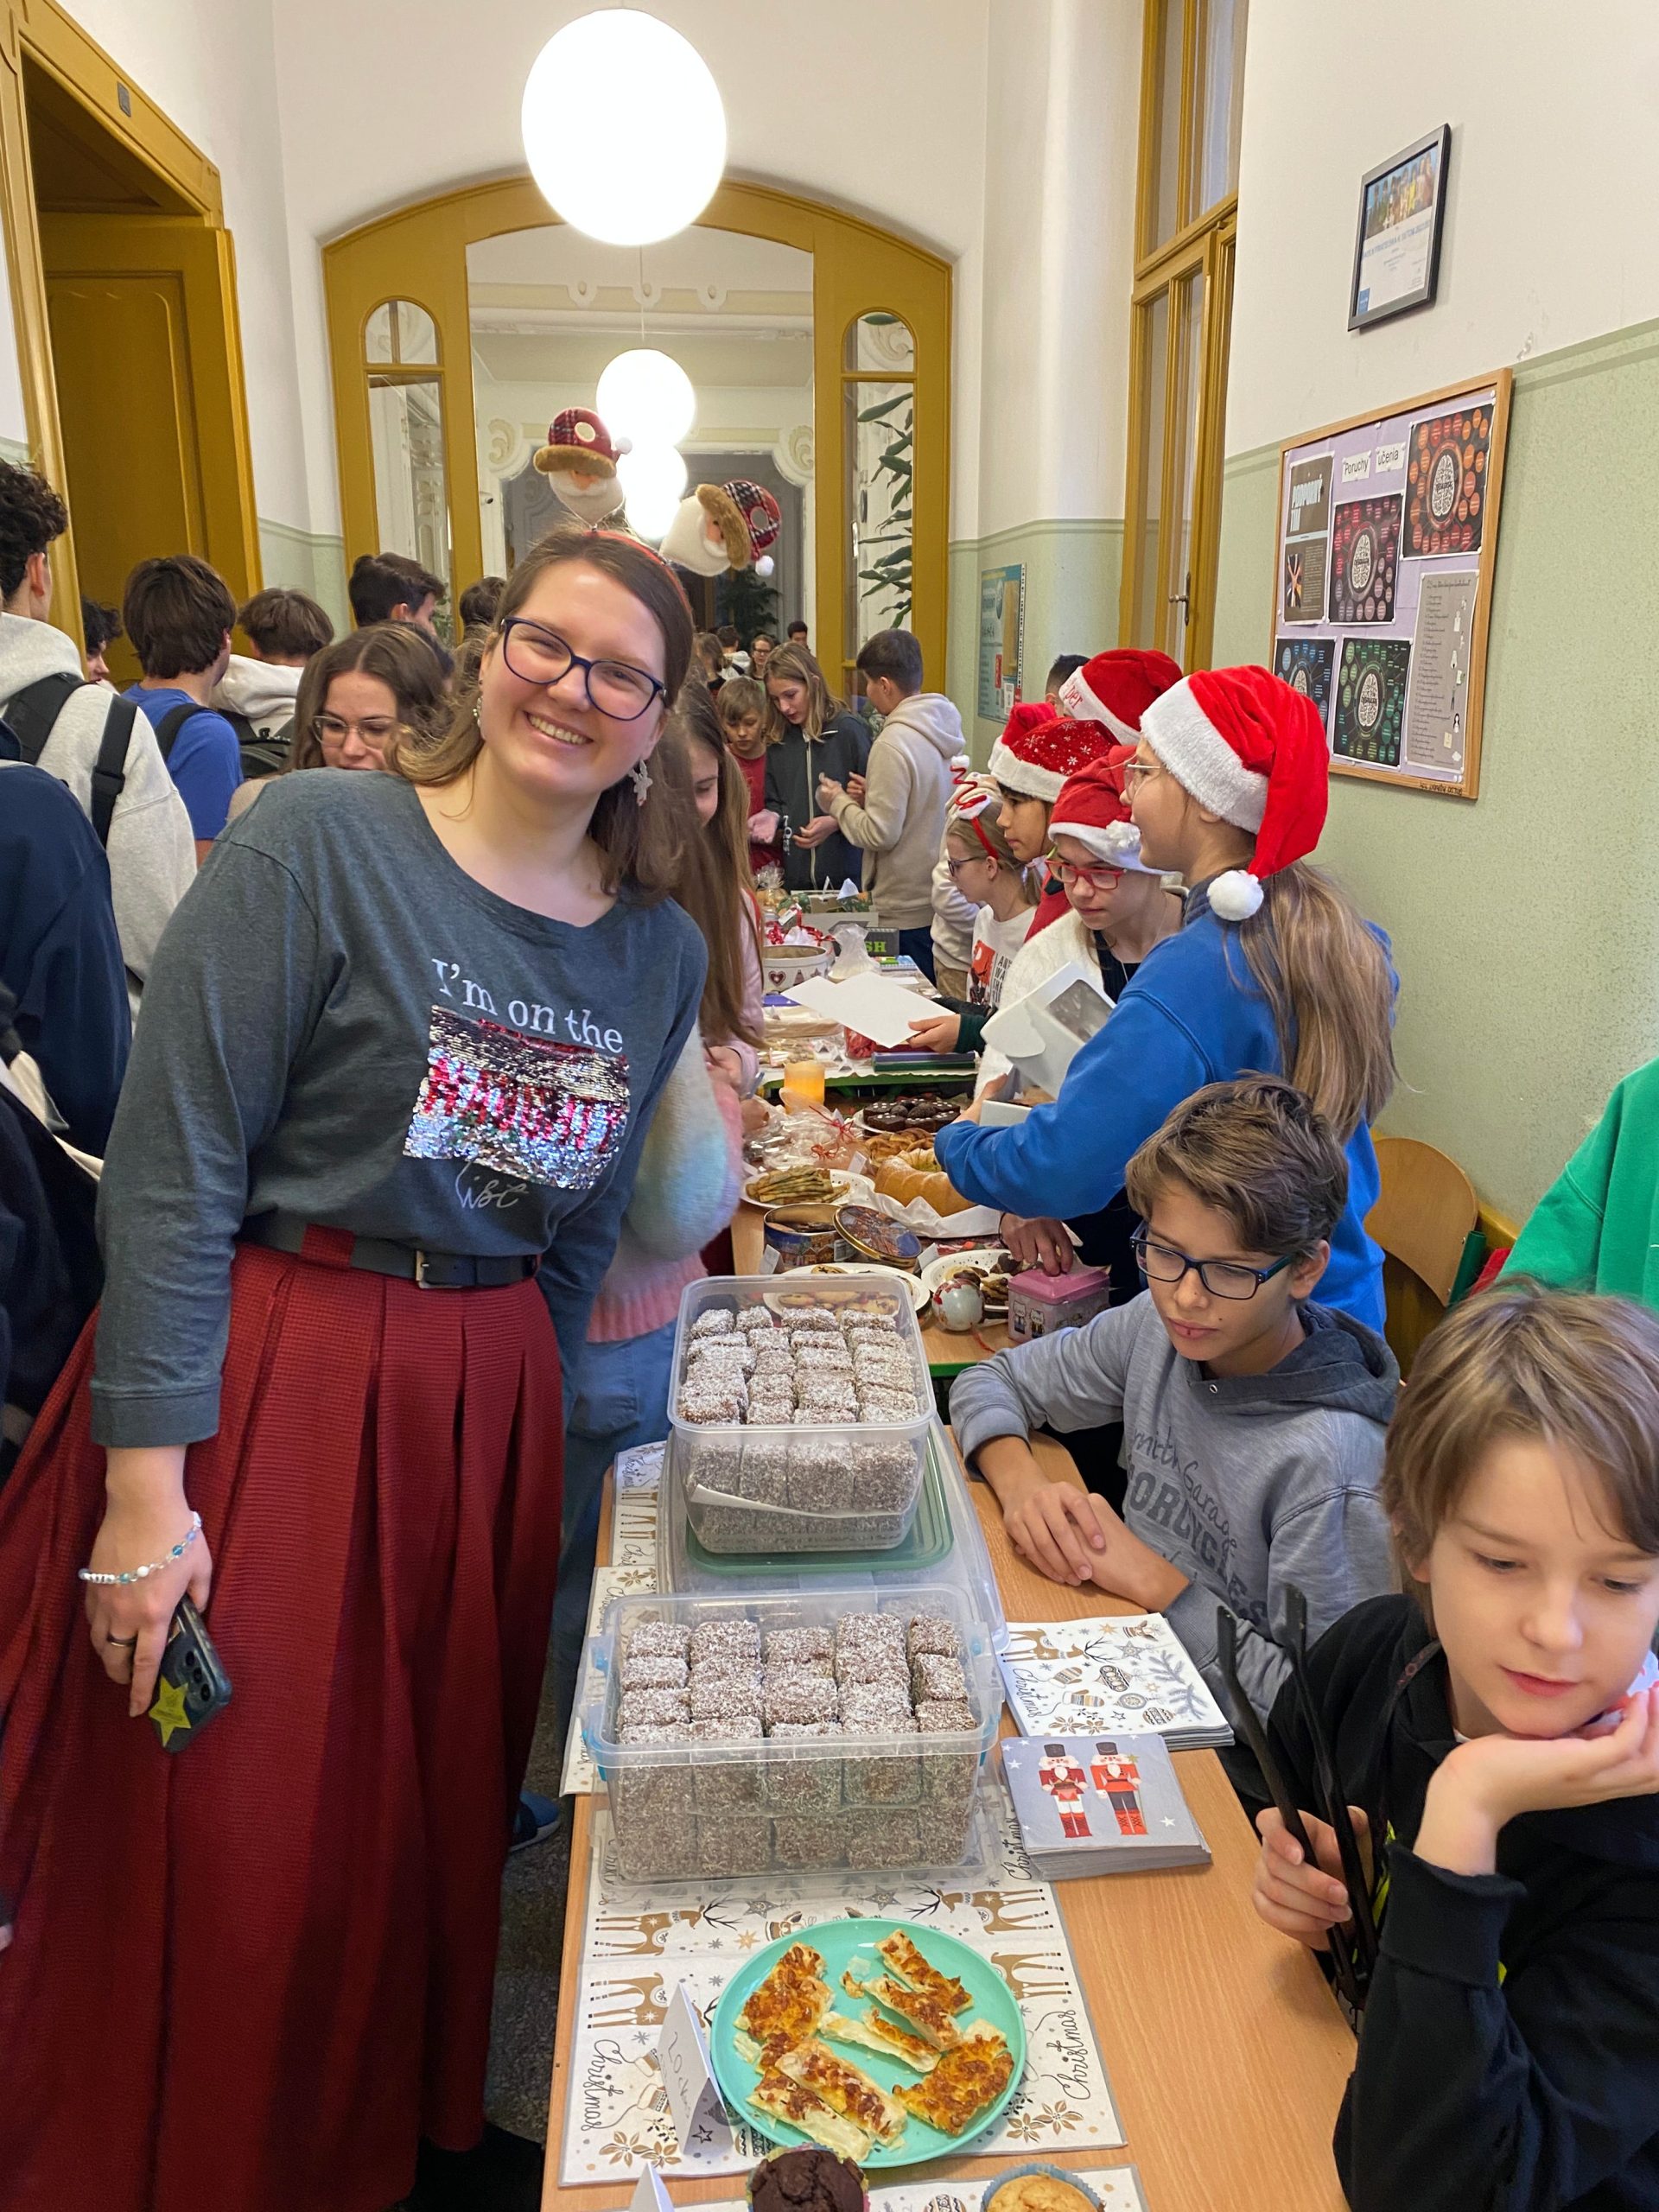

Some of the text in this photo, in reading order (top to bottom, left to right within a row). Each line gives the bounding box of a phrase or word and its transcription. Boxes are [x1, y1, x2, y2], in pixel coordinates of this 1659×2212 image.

[1344, 458, 1369, 475] Poruchy
[431, 957, 624, 1054] I'm on the
[1012, 1668, 1049, 1718] Christmas
[580, 2038, 624, 2132] Christmas
[1046, 2009, 1090, 2101] Christmas
